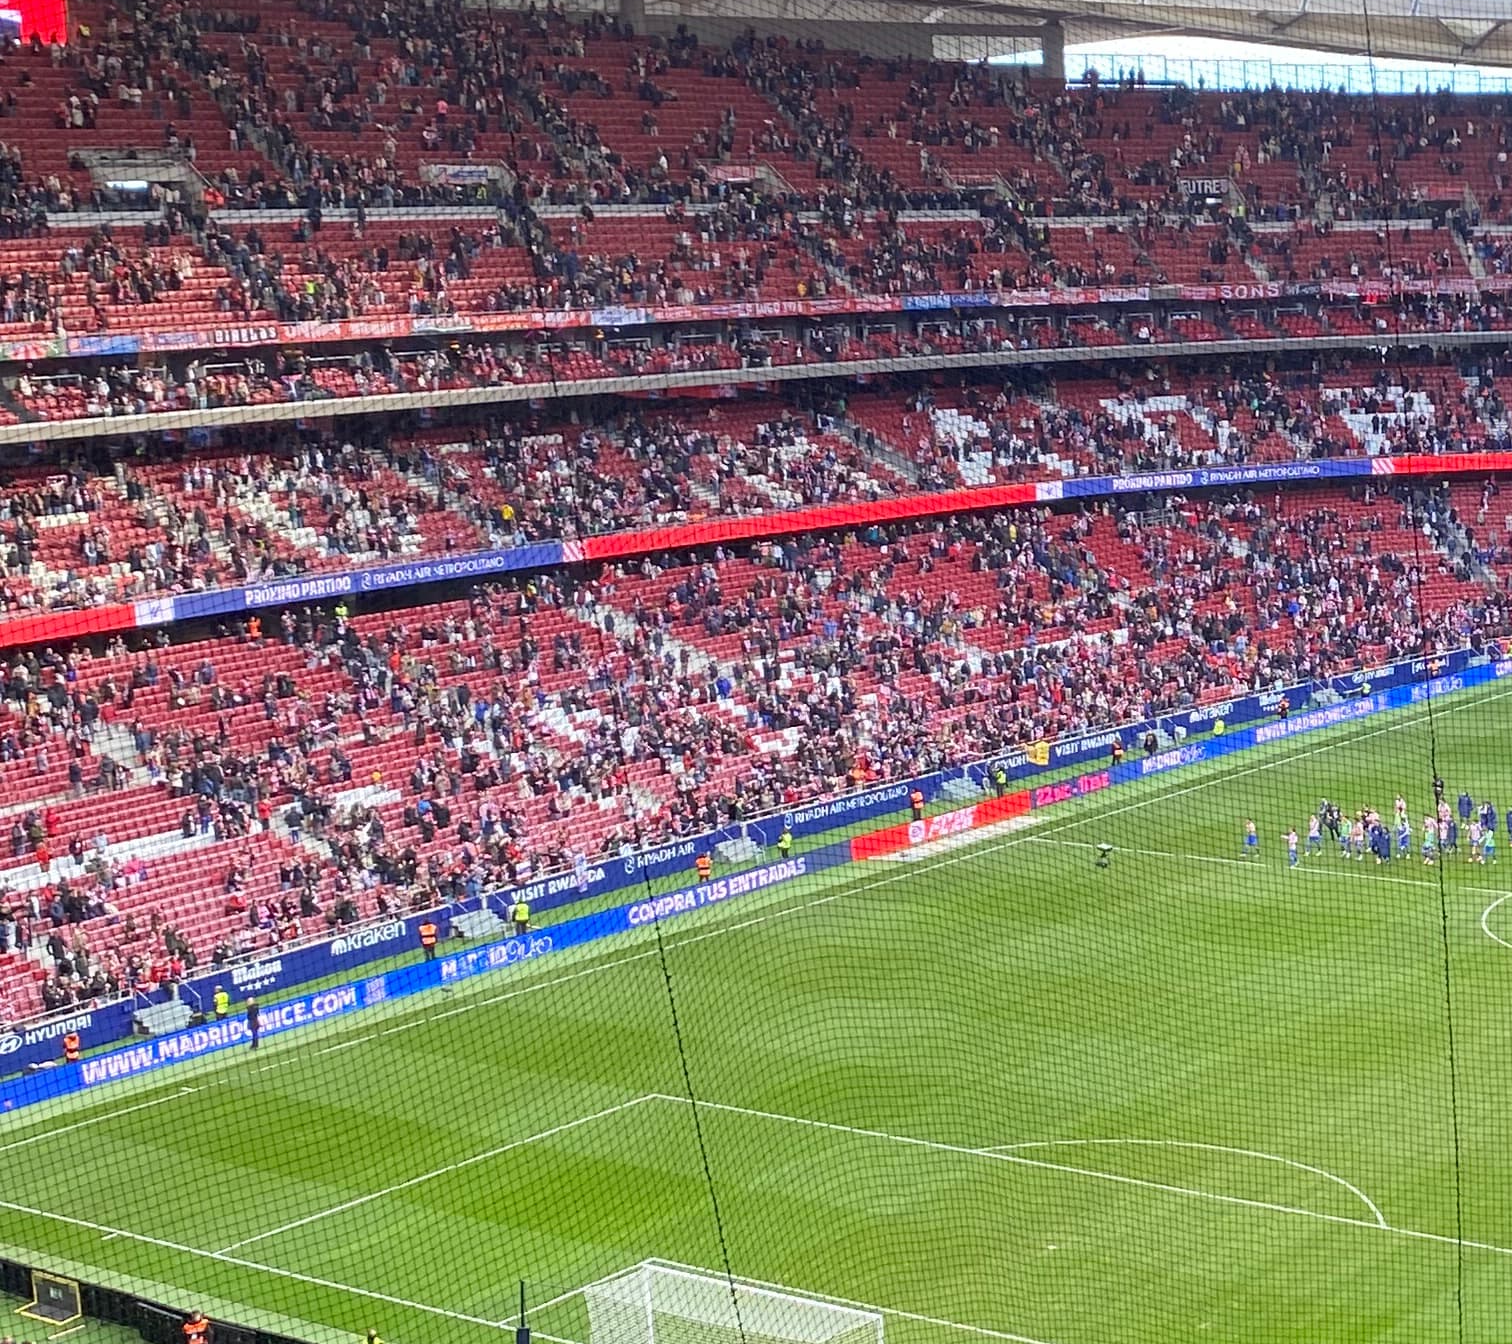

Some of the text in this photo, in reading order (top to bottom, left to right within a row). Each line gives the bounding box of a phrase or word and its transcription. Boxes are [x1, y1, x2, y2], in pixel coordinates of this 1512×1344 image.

[1154, 473, 1192, 487] PARTIDO
[373, 568, 412, 585] RIYADH
[413, 566, 432, 579] AIR
[245, 576, 351, 605] PRÓXIMO PARTIDO
[1056, 740, 1080, 756] VISIT
[1142, 753, 1180, 774] MADRID
[795, 805, 828, 824] RIYADH
[829, 802, 844, 816] AIR
[637, 840, 695, 868] RIYADH AIR
[511, 868, 605, 905] VISIT RWADA
[629, 857, 806, 924] COMPRA TUS ENTRADAS
[347, 920, 405, 951] kraken
[25, 1014, 92, 1045] HYUNDAI
